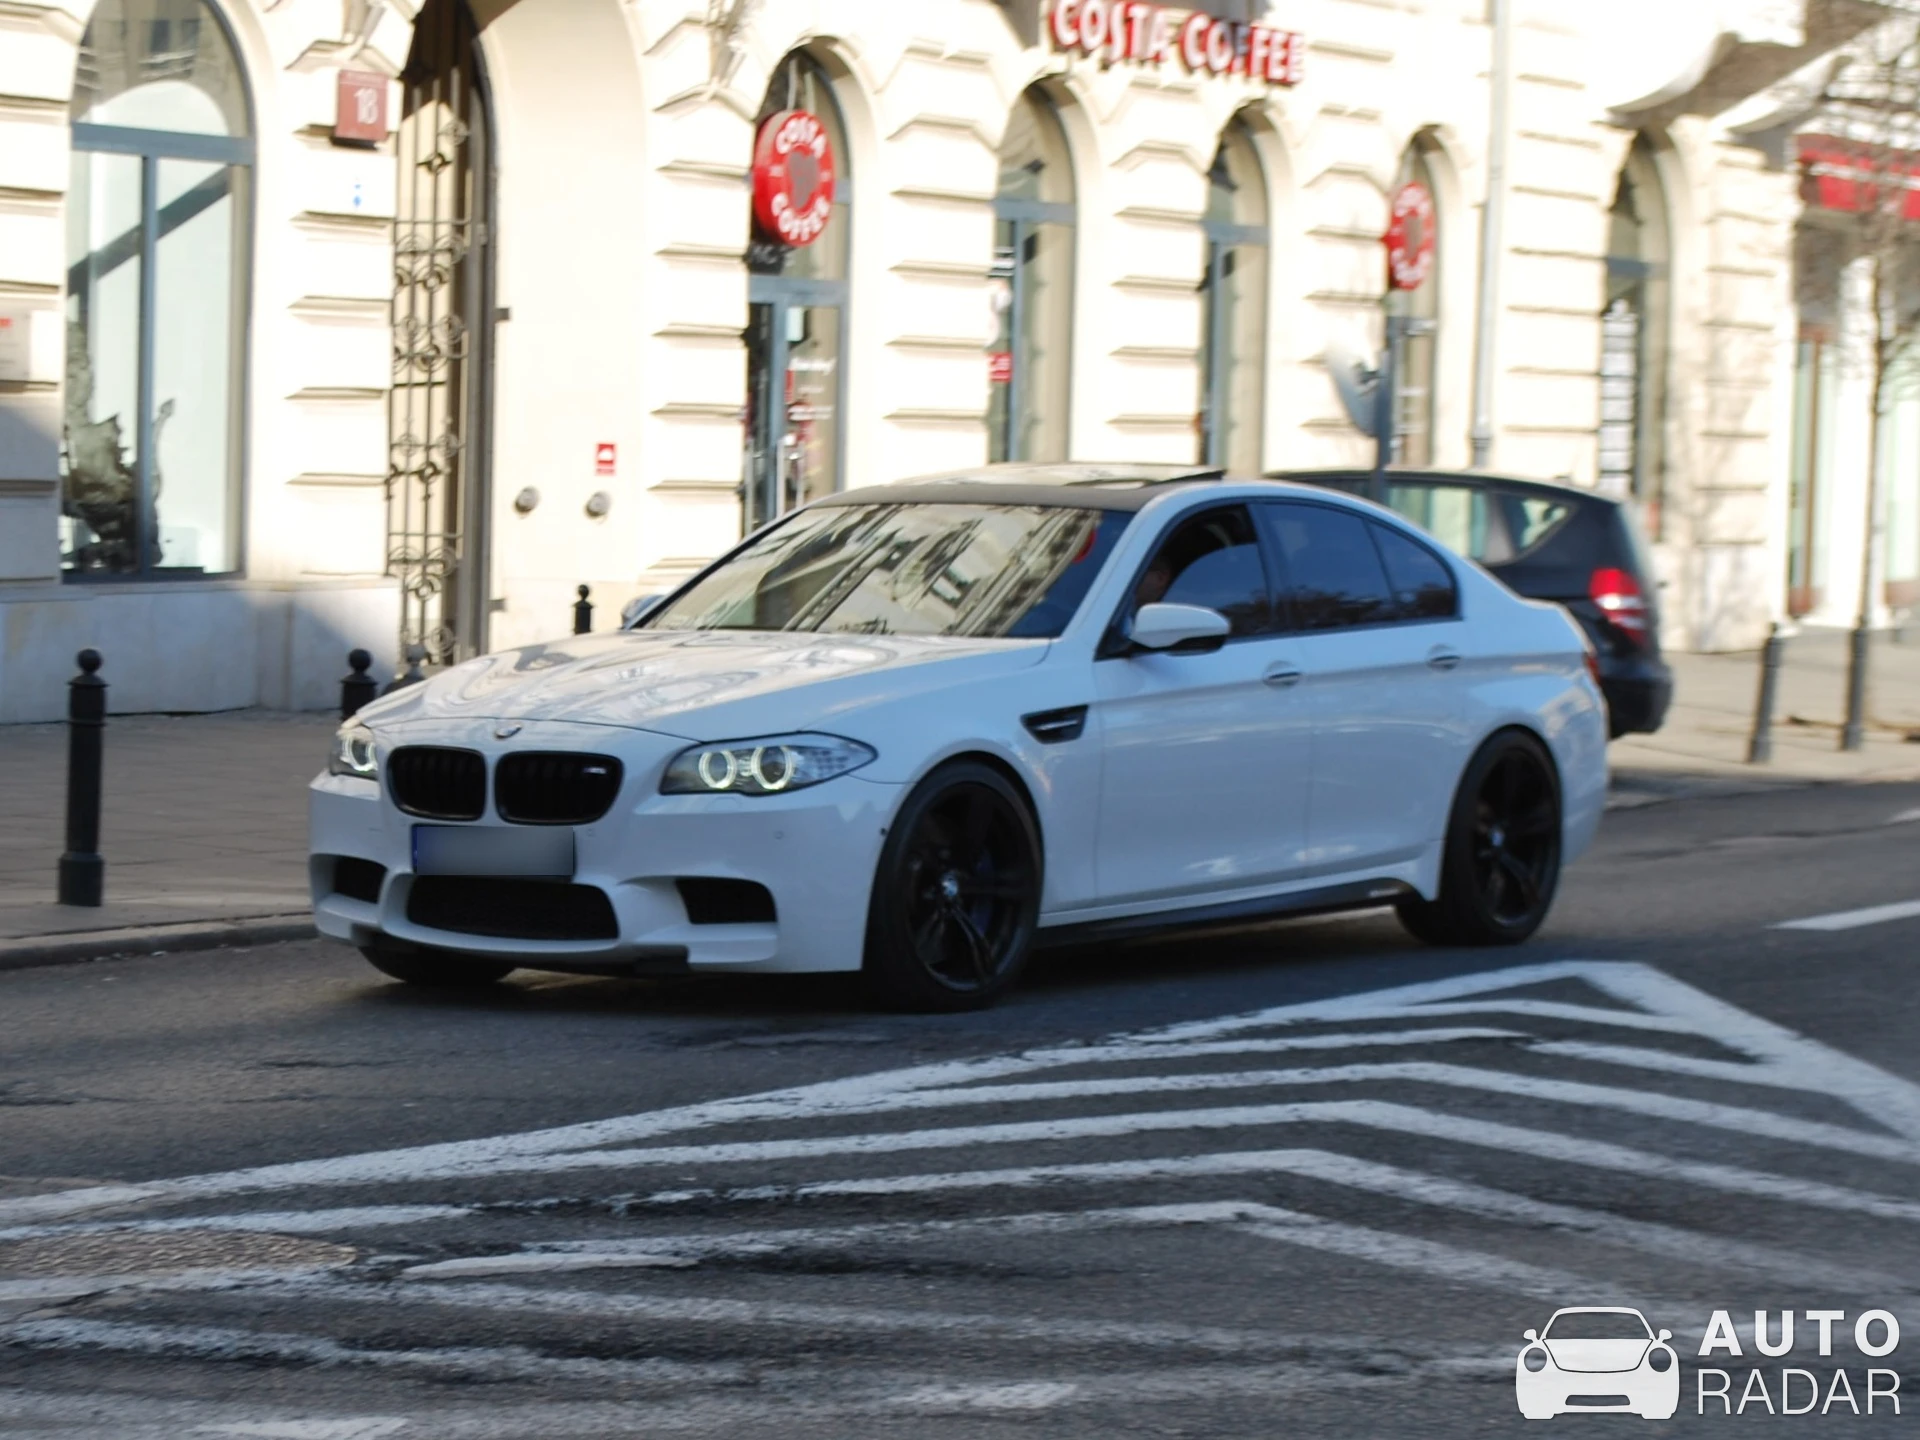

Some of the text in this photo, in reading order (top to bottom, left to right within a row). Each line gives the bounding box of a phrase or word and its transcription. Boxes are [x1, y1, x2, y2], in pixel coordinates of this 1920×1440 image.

[1053, 0, 1304, 82] COSTA COFFEE
[353, 87, 379, 124] 18
[775, 116, 827, 158] COSTA
[771, 192, 830, 241] COFFEE
